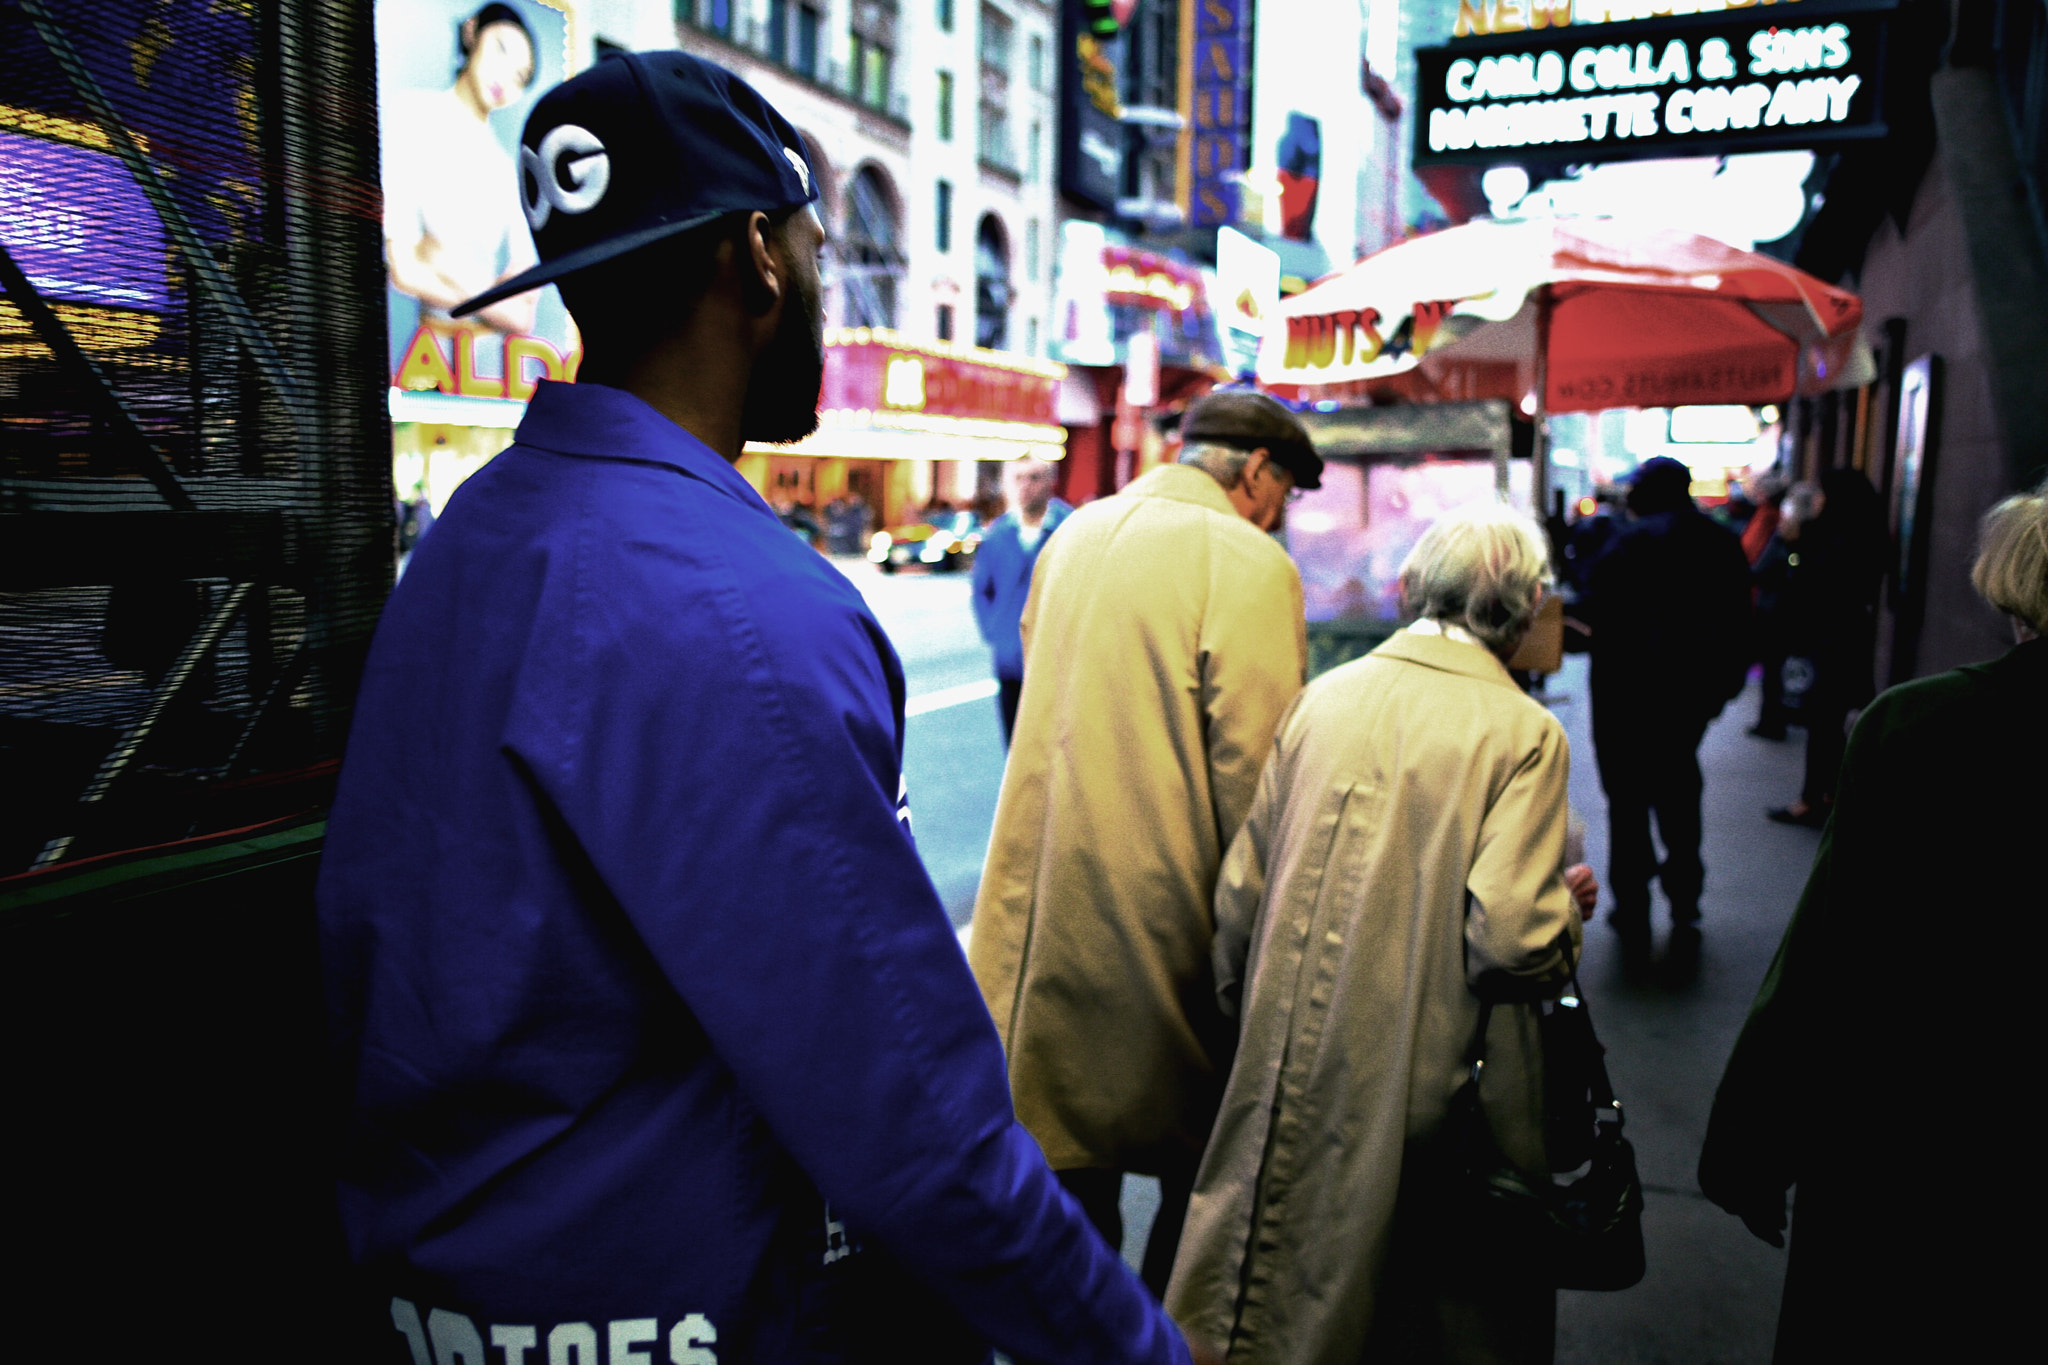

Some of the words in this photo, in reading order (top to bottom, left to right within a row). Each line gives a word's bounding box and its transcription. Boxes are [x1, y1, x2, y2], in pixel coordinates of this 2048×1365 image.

[1445, 50, 1565, 101] CARLO
[1569, 40, 1691, 92] COLLA
[1699, 38, 1735, 80] &
[1749, 23, 1850, 75] SONS
[1665, 75, 1861, 134] COMPANY
[394, 325, 583, 402] ALD
[1283, 307, 1385, 370] NUTS
